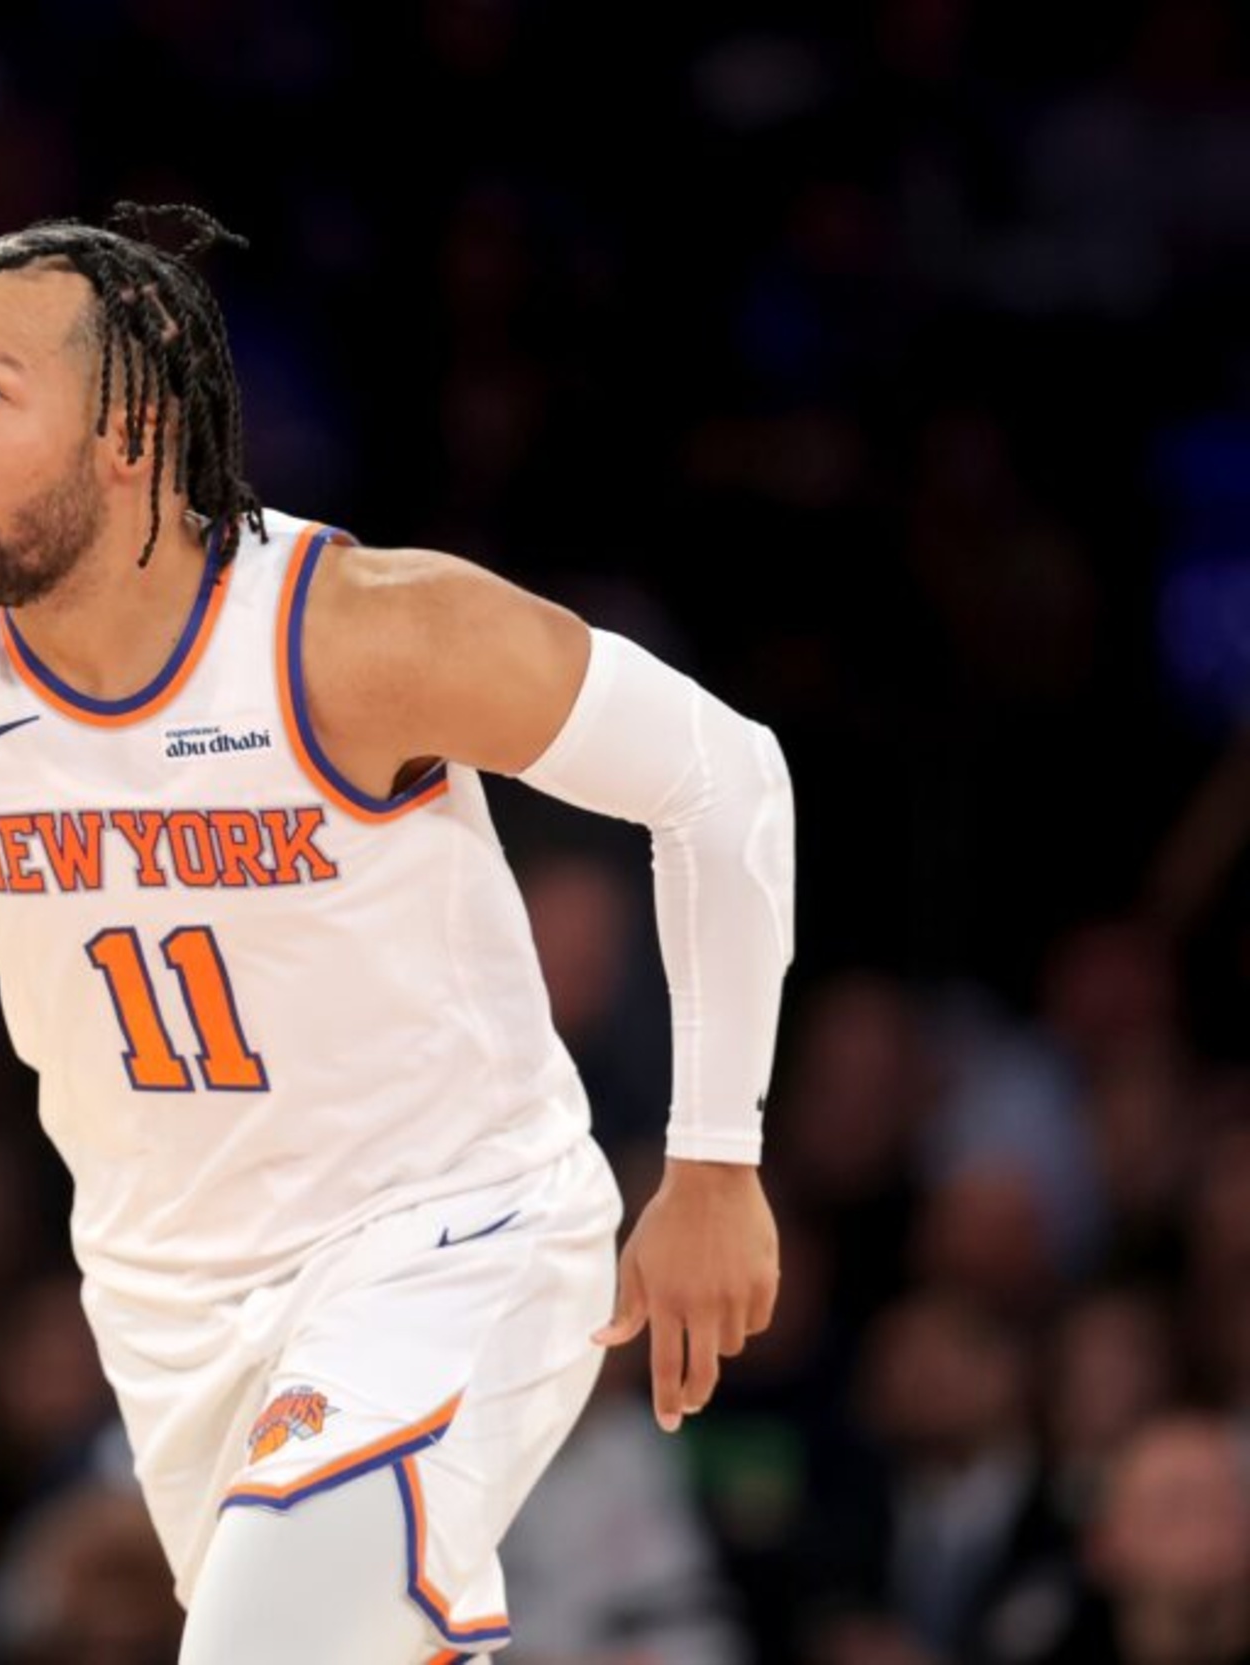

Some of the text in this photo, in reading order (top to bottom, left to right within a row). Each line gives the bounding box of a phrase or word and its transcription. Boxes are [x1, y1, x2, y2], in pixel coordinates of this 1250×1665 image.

[165, 730, 271, 758] abu dhabi
[109, 807, 339, 888] YORK
[83, 925, 271, 1093] 11
